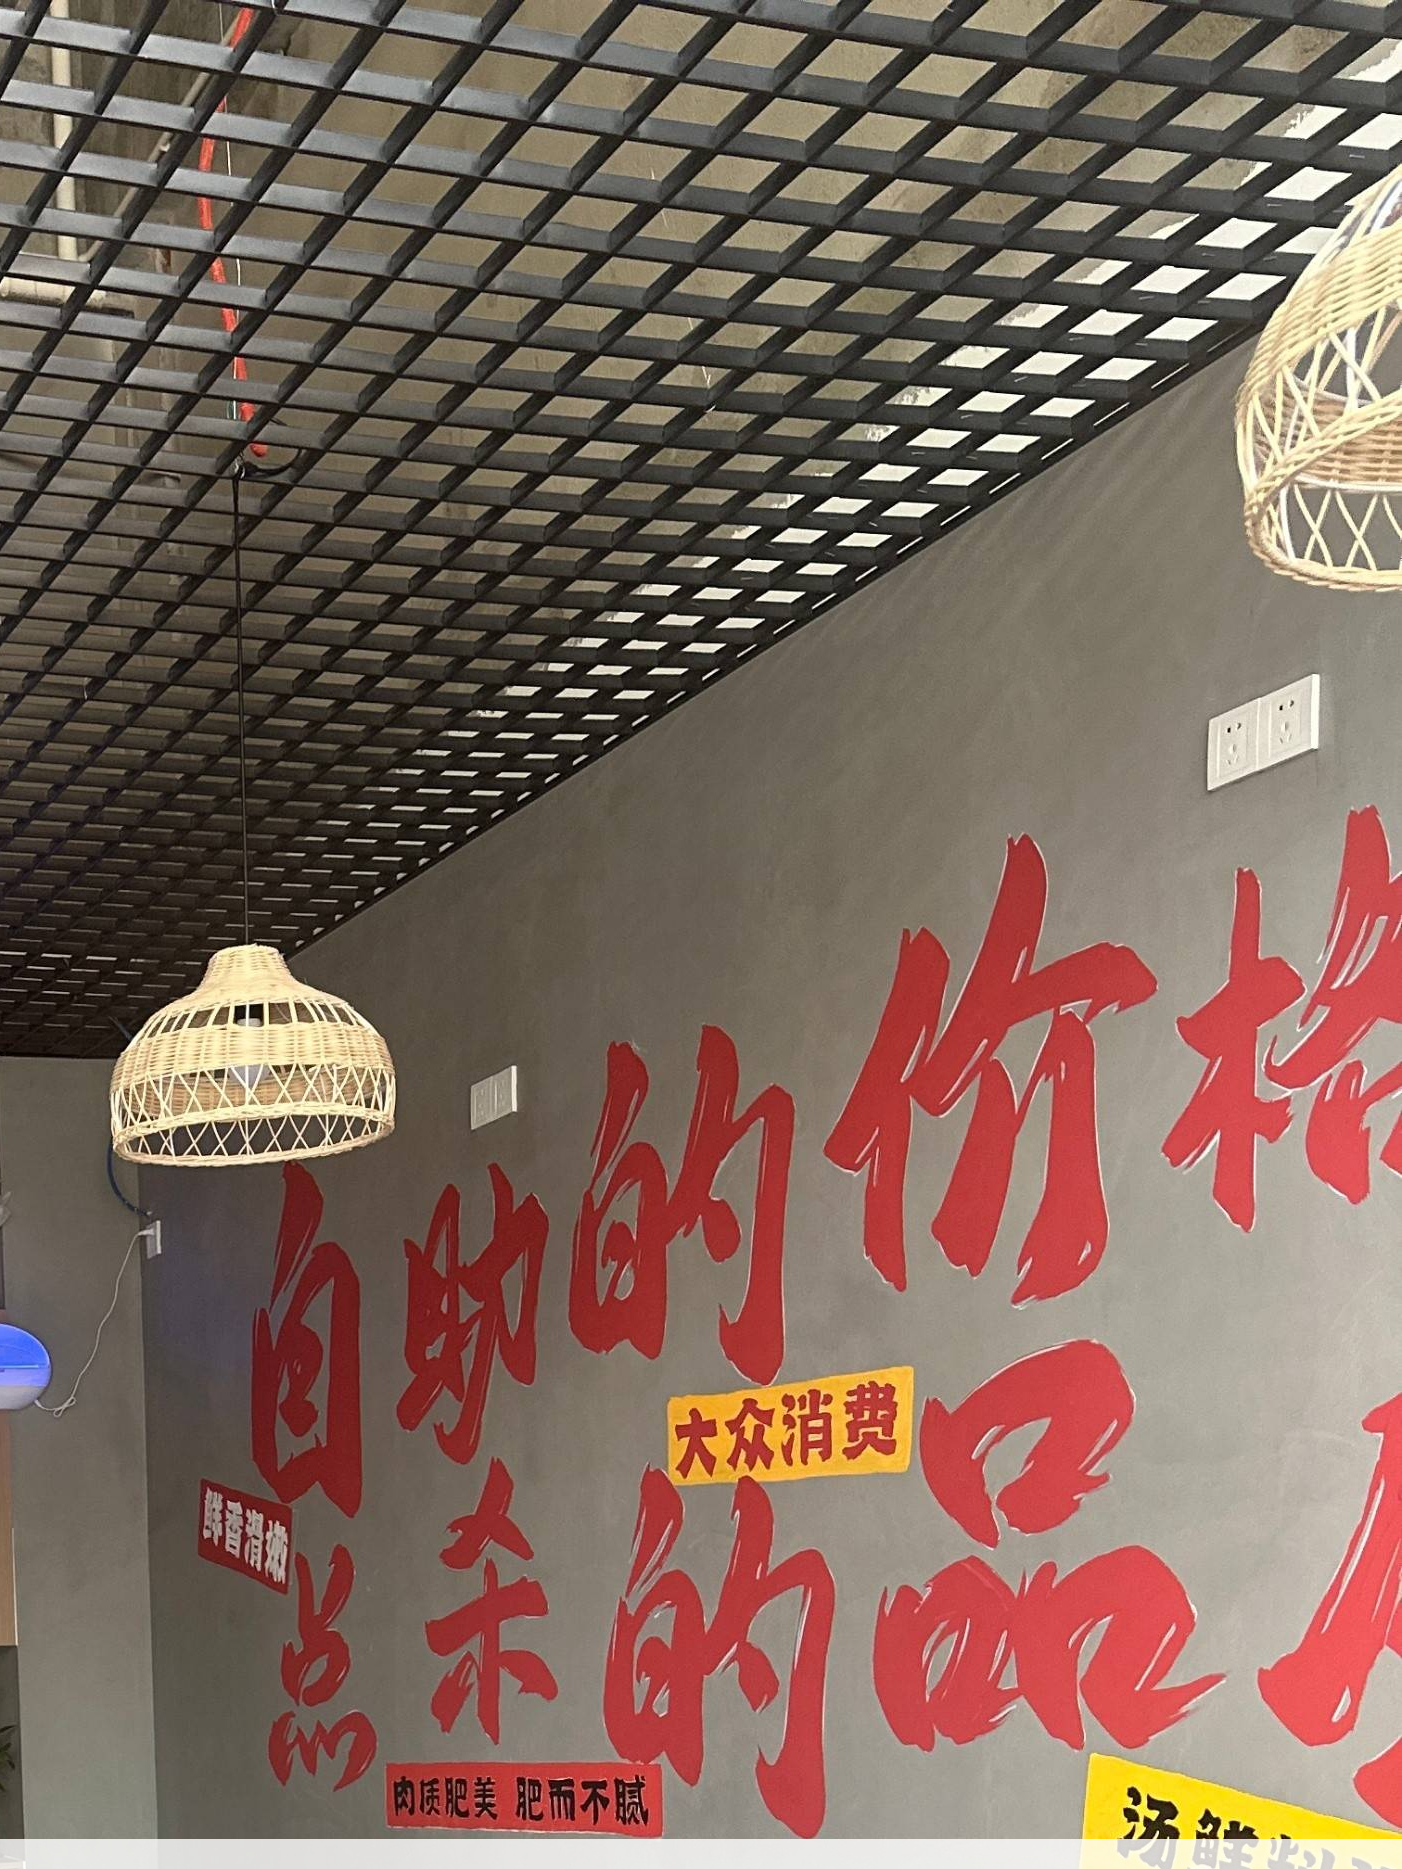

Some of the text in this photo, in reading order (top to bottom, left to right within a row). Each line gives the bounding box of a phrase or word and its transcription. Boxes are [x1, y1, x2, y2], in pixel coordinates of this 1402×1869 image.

[675, 1380, 898, 1479] 大众消费
[202, 1486, 289, 1585] 鲜香滑嫩
[393, 1775, 650, 1827] 肉质肥美 肥而不腻
